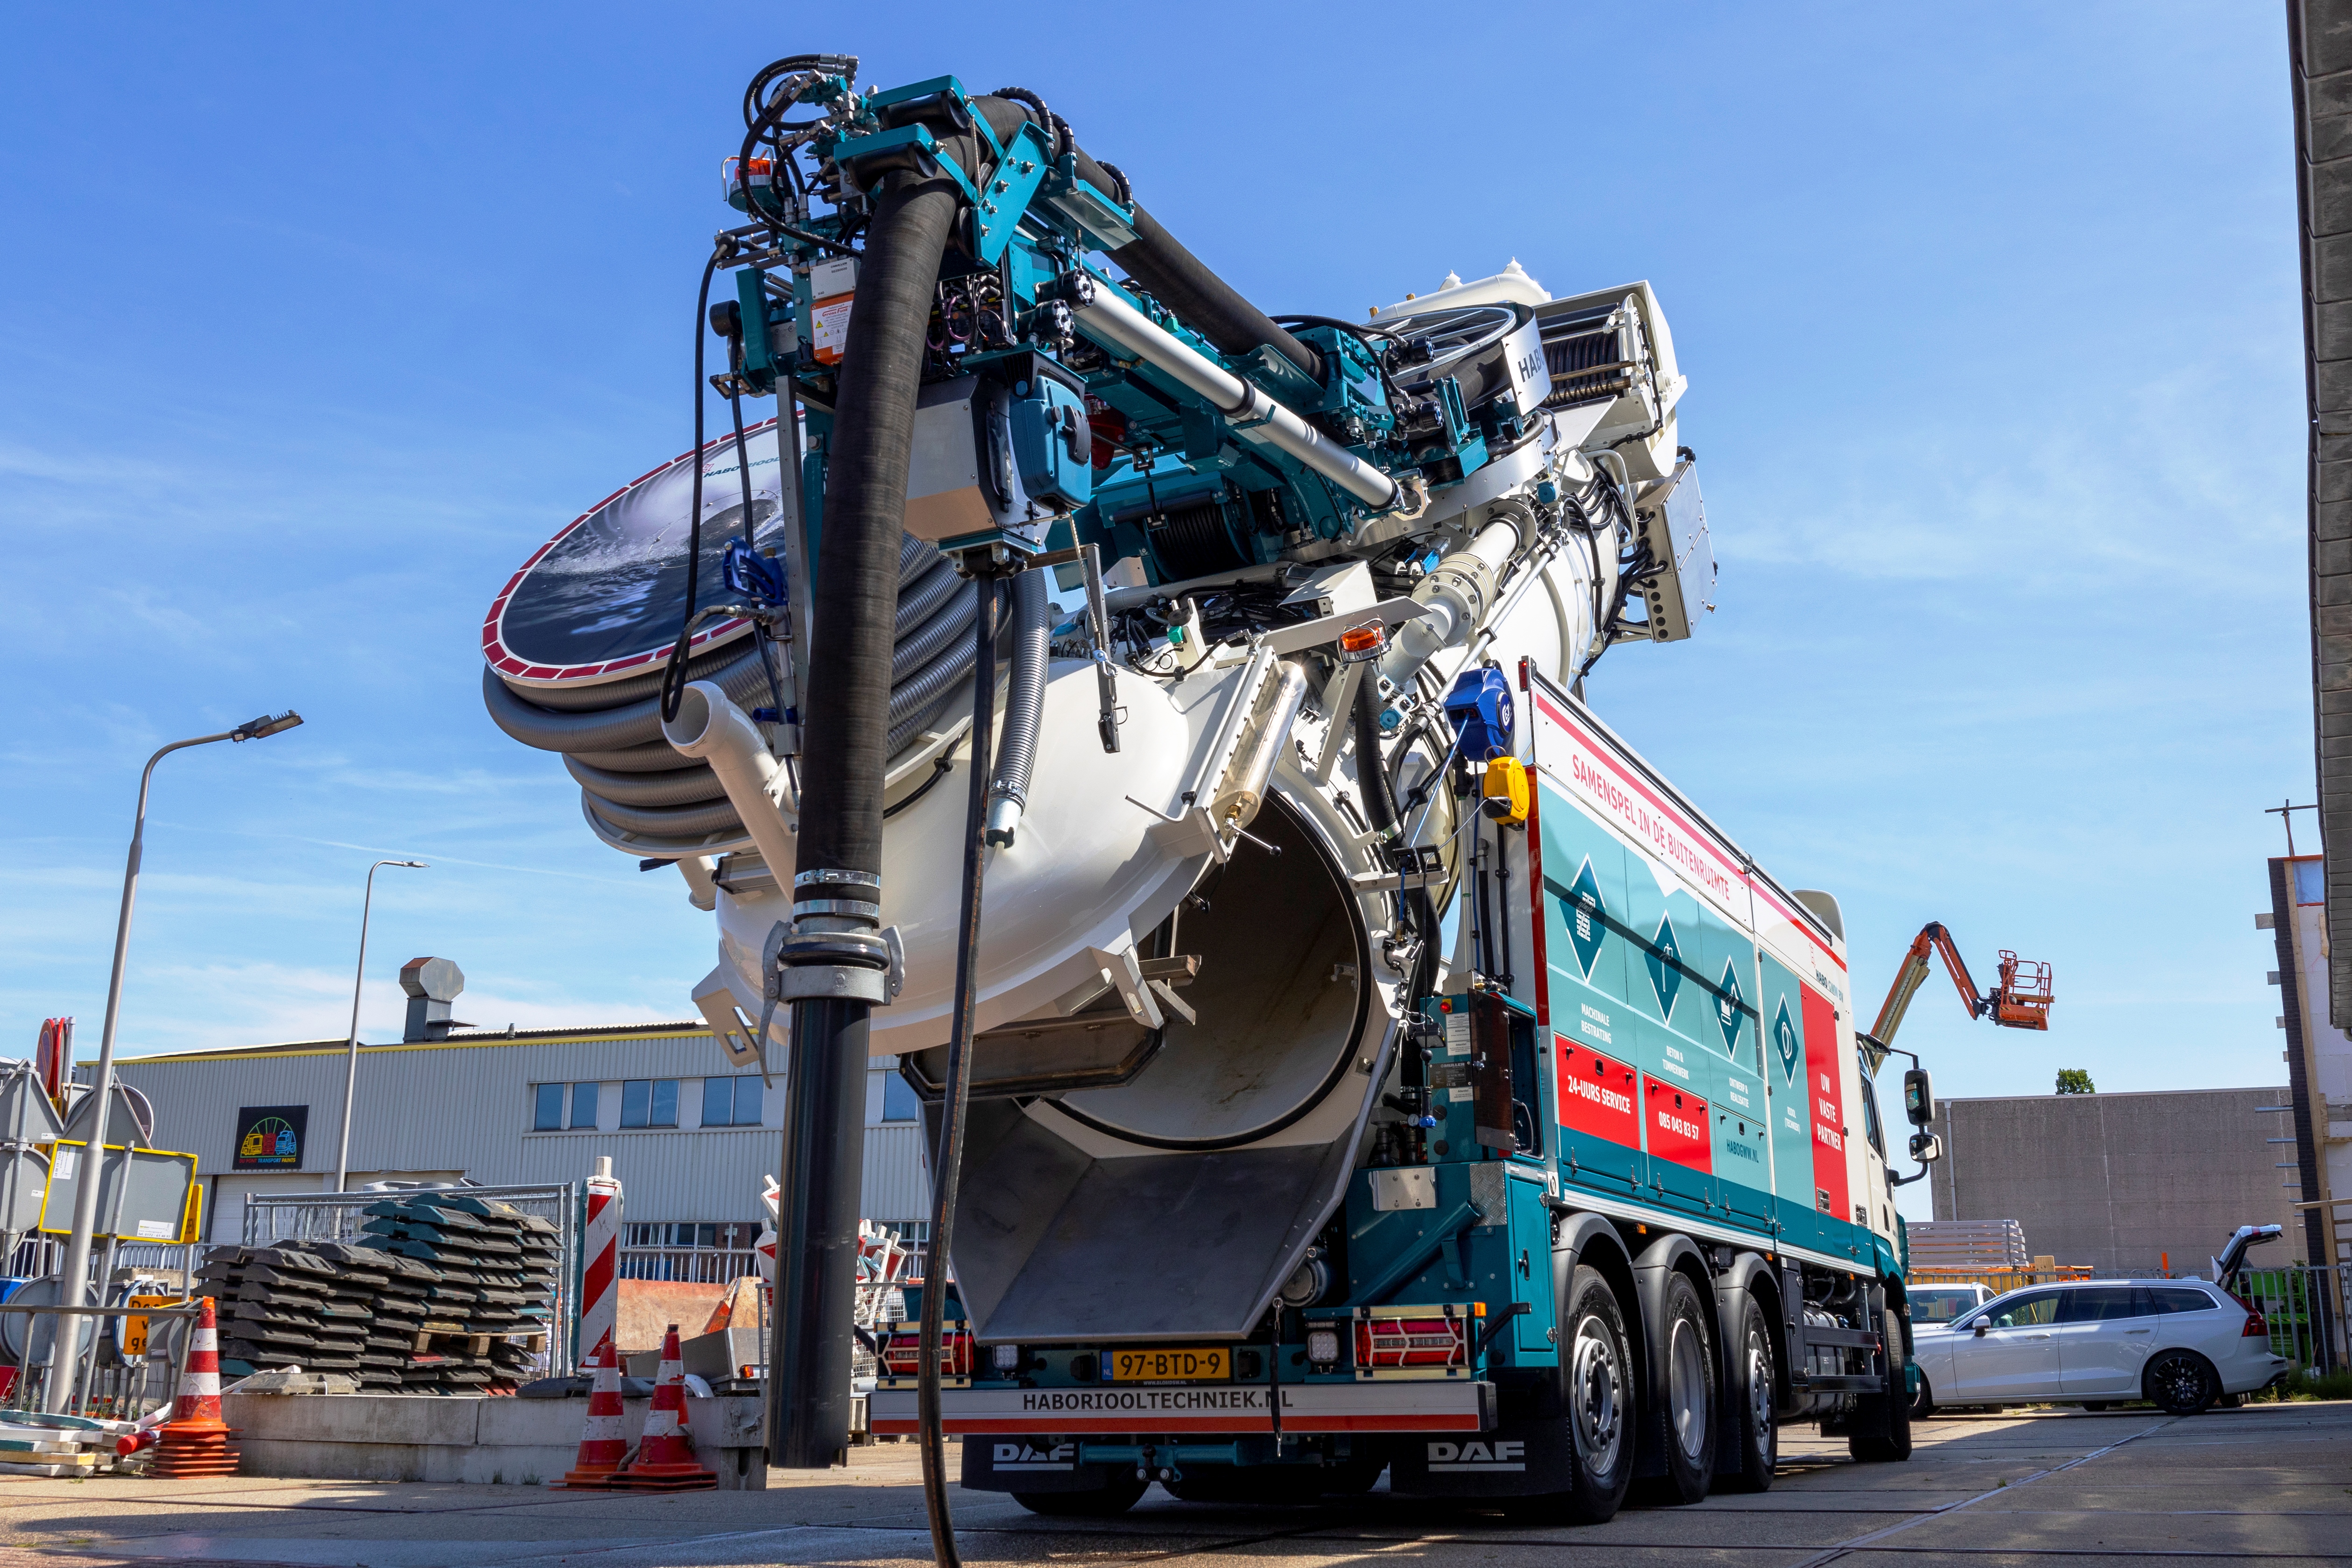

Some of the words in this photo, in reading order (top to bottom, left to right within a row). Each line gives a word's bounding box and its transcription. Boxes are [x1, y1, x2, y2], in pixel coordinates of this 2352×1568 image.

[703, 466, 741, 478] HABO
[1573, 754, 1636, 826] SAMENSPEL
[1639, 807, 1650, 837] IN
[1653, 819, 1666, 849] DE
[1667, 832, 1730, 901] BUITENRUIMTE
[1815, 969, 1828, 989] HABO
[1581, 1003, 1610, 1027] MACHINALE
[1581, 1020, 1611, 1044] BESTRATING
[1666, 1045, 1680, 1061] BETON
[1680, 1052, 1684, 1063] &
[1662, 1059, 1689, 1080] TIMMERWERK
[1568, 1075, 1600, 1103] 24-UURS
[1602, 1088, 1631, 1114] SERVICE
[1729, 1077, 1745, 1093] ONTWERP
[1745, 1086, 1749, 1095] &
[1820, 1073, 1830, 1094] UW
[1730, 1091, 1749, 1108] REALISATIE
[1818, 1097, 1836, 1123] VASTE
[1659, 1111, 1670, 1129] 085
[1672, 1116, 1682, 1134] 043
[1683, 1121, 1691, 1137] 83
[1692, 1124, 1699, 1140] 57
[1817, 1123, 1842, 1151] PARTNER
[1726, 1138, 1759, 1163] HABOGWW.NL
[1120, 1353, 1220, 1376] 97-BTD-9
[993, 1443, 1074, 1461] DAF
[1427, 1441, 1525, 1461] DAF
